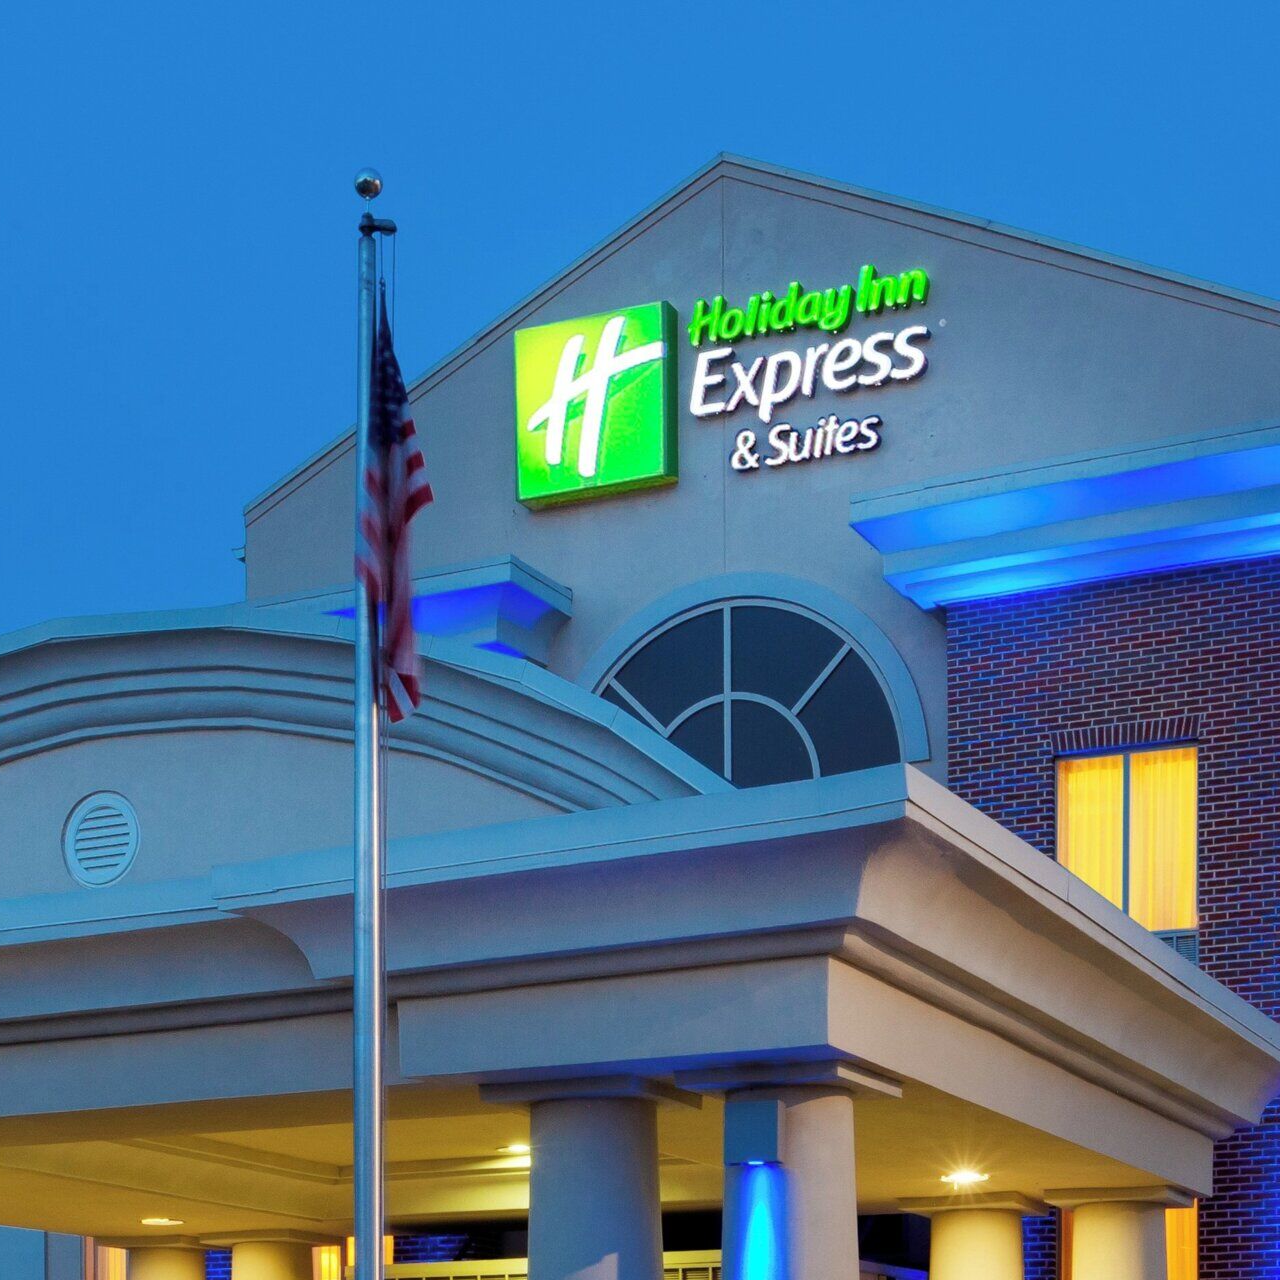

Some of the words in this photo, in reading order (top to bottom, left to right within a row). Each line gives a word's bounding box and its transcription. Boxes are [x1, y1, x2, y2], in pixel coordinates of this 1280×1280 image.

[687, 281, 853, 347] Holiday
[855, 264, 930, 312] Inn
[689, 325, 930, 424] Express
[730, 429, 760, 470] &
[763, 414, 881, 467] Suites
